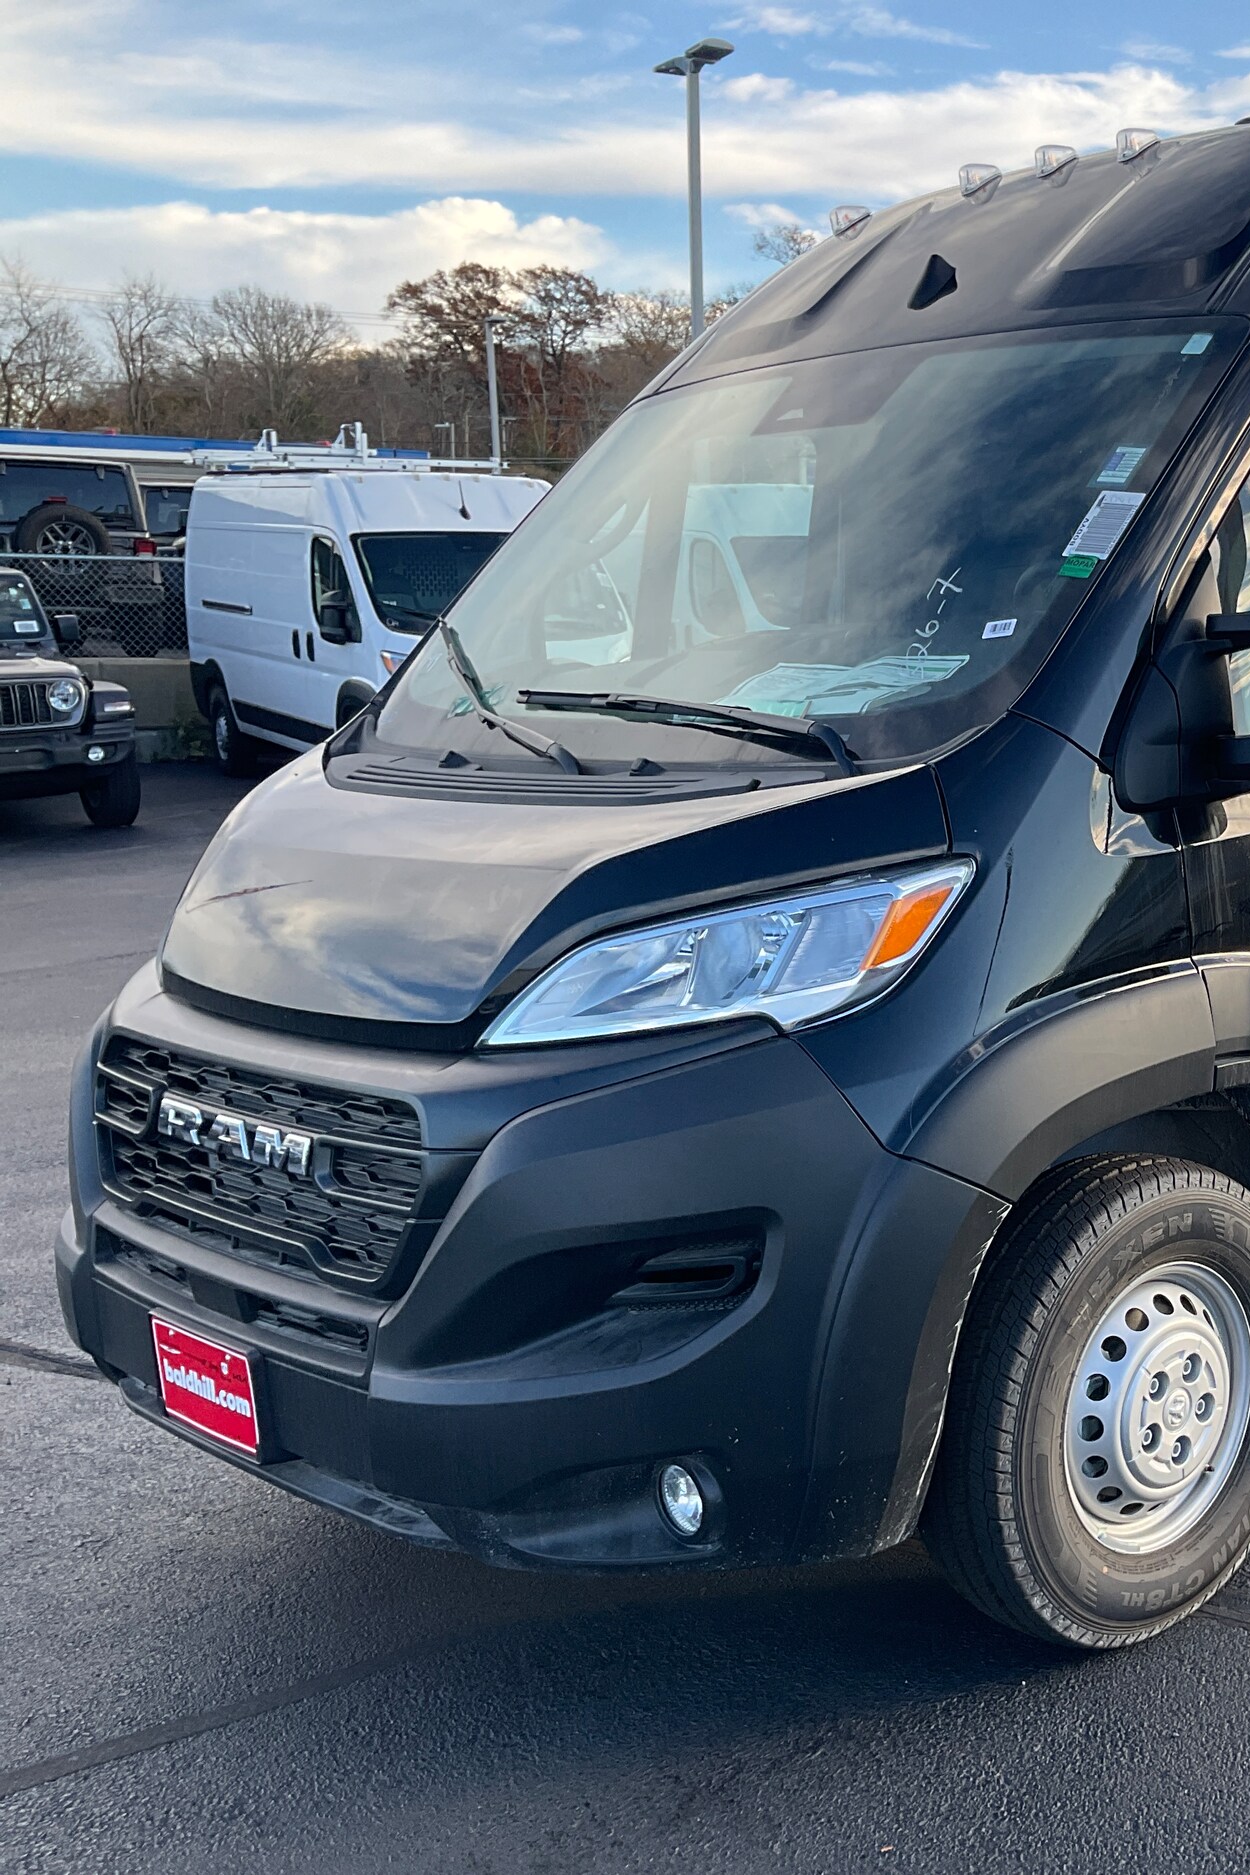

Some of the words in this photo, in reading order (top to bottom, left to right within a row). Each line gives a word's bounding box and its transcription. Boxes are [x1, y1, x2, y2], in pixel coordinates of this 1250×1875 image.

[1066, 558, 1095, 569] MOPAR
[157, 1098, 312, 1176] RAM
[1066, 1211, 1194, 1336] NEXEN
[162, 1357, 251, 1418] baldhill.com
